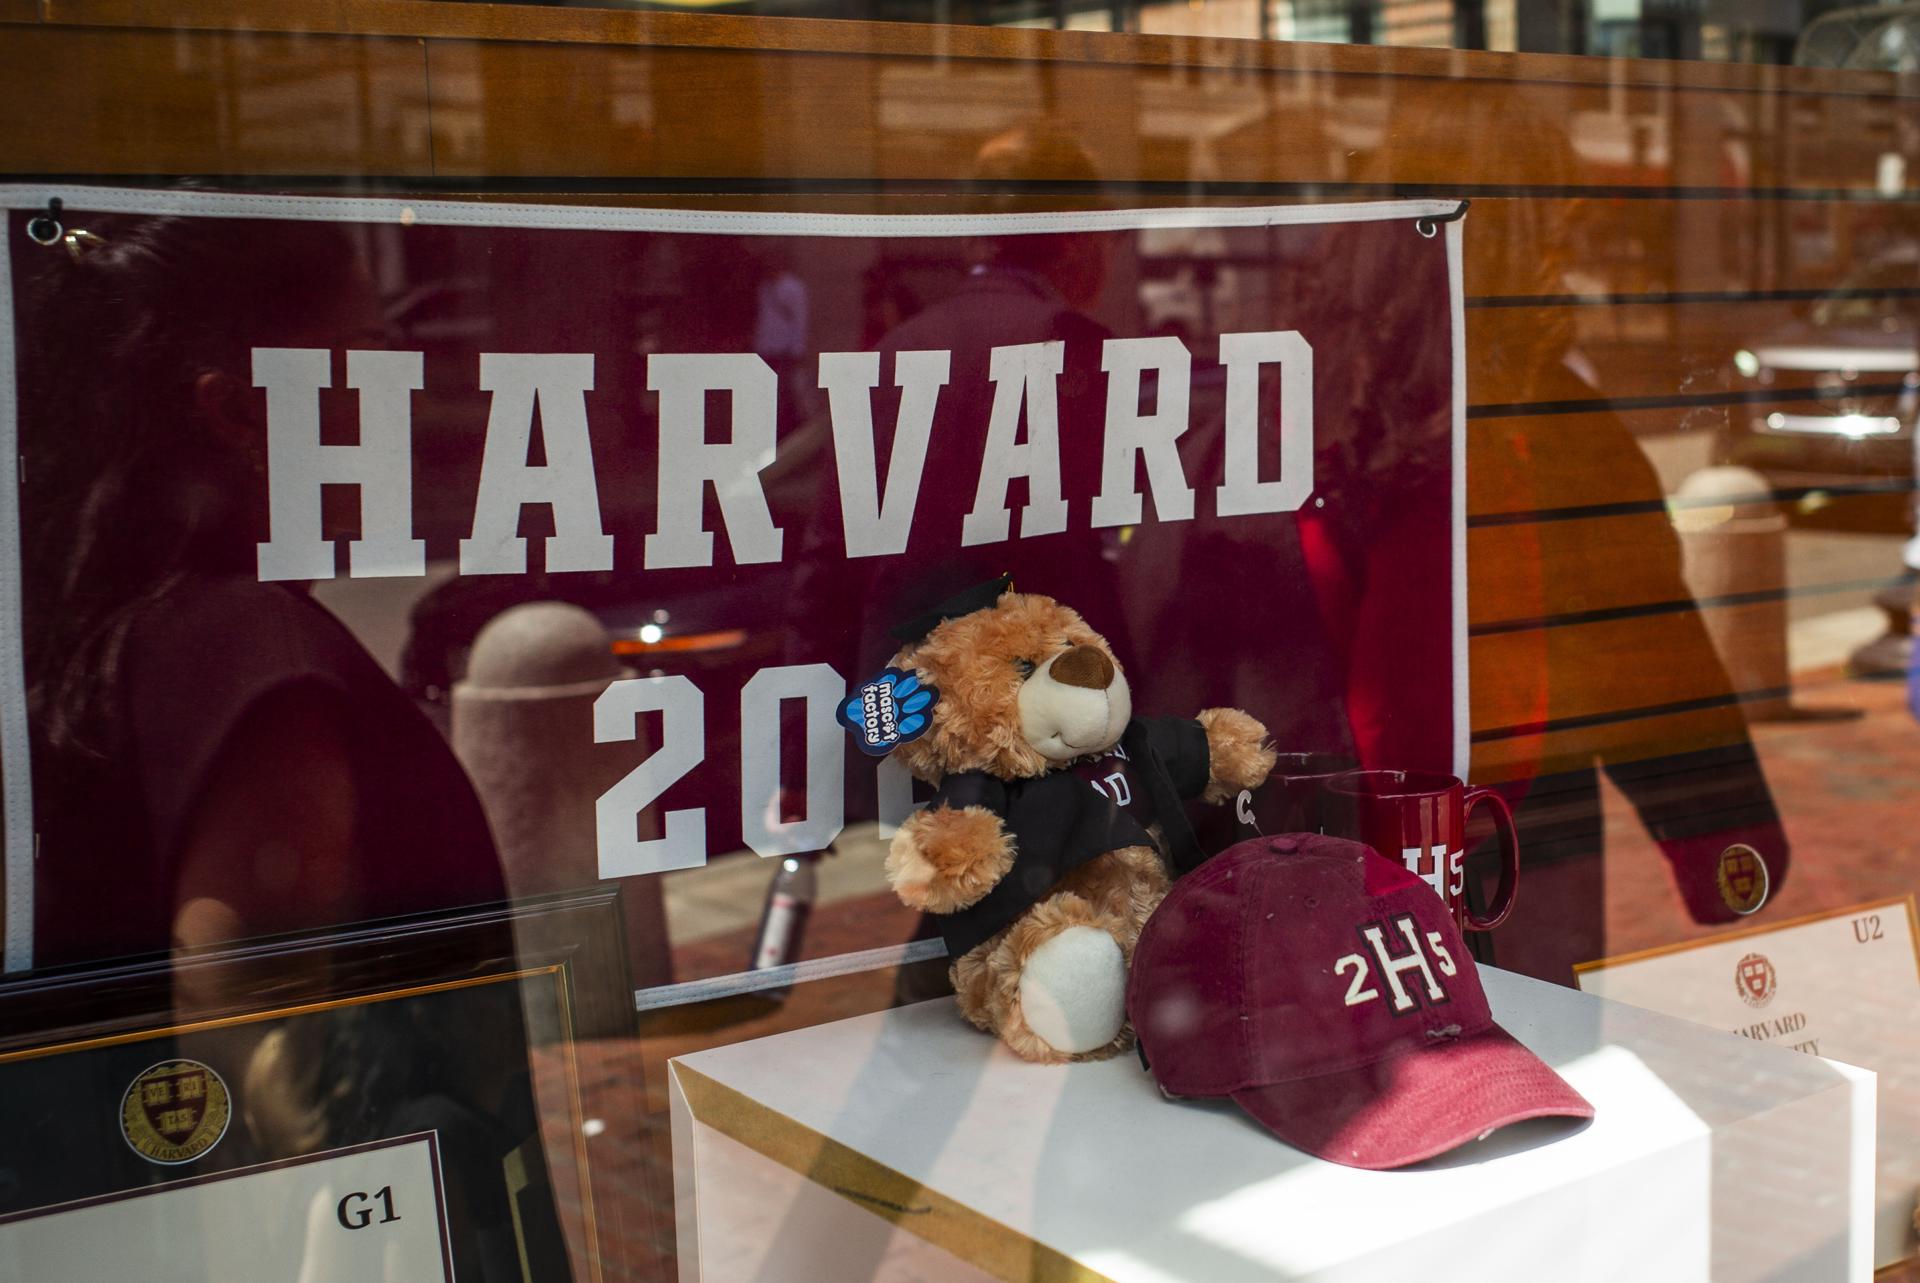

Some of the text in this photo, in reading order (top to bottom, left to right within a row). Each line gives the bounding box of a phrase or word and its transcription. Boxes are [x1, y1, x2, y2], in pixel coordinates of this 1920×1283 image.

[251, 331, 1315, 581] HARVARD
[863, 684, 881, 743] factory
[1852, 915, 1884, 943] U2
[1734, 1012, 1806, 1041] ARVARD
[337, 1186, 401, 1230] G1
